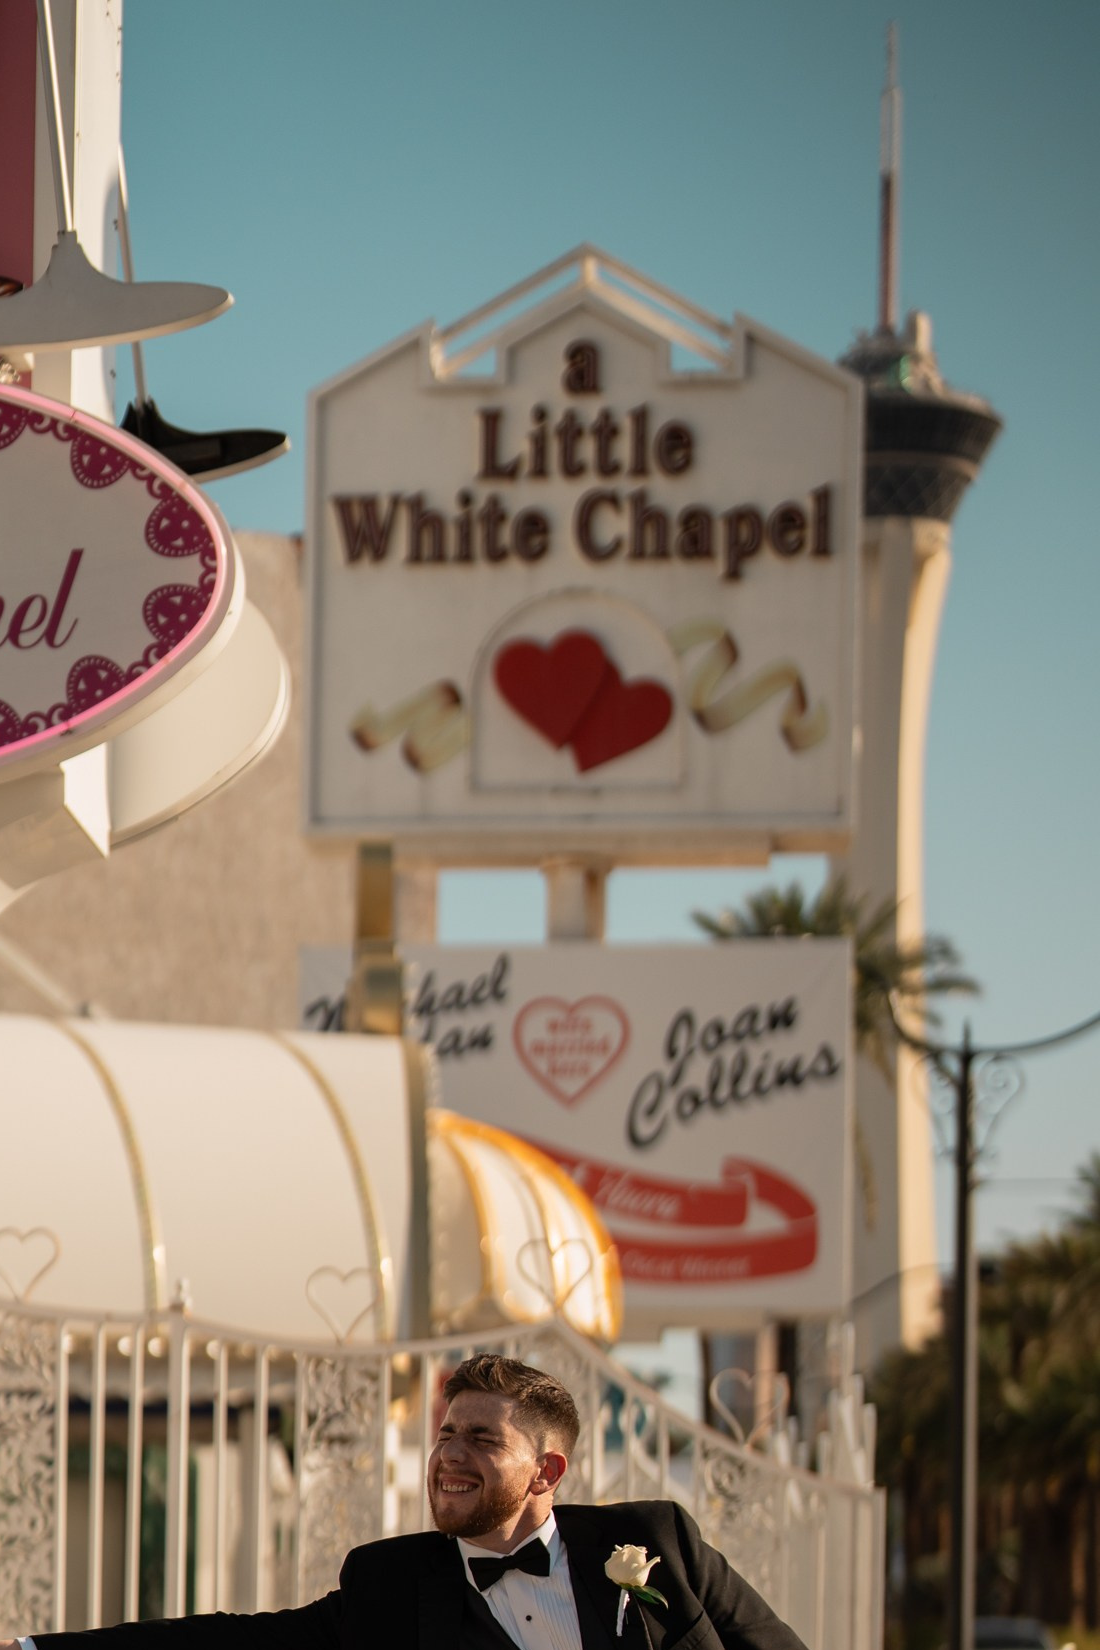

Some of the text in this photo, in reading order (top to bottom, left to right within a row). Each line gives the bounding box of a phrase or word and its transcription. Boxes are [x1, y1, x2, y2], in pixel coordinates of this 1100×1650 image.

[562, 339, 602, 396] a
[477, 402, 697, 482] Little
[332, 481, 835, 581] White Chapel
[663, 995, 799, 1087] Joan
[626, 1041, 842, 1152] Collins
